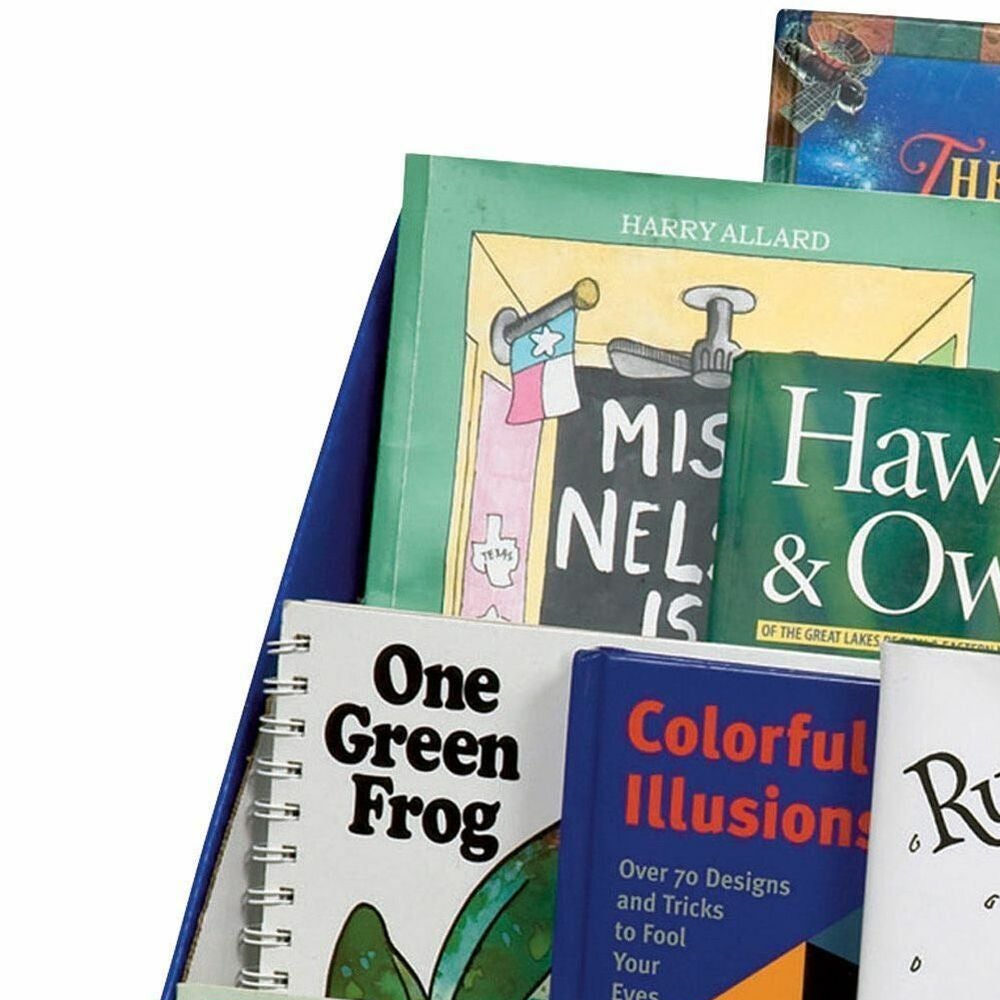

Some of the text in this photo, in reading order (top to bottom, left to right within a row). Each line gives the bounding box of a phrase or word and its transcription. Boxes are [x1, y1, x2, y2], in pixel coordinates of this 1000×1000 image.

[620, 214, 831, 252] HARRY ALLARD
[556, 486, 718, 584] NEL
[762, 534, 831, 607] &
[641, 589, 703, 640] IS
[761, 624, 777, 637] OF
[780, 625, 802, 640] THE
[804, 627, 842, 644] GREAT
[845, 631, 880, 647] LAKES
[373, 643, 501, 713] One
[324, 703, 521, 781] Green
[627, 699, 870, 776] Colorful
[347, 773, 501, 863] Frog
[619, 858, 791, 898] Over 70 Designs
[617, 892, 725, 920] and Tricks
[614, 921, 686, 947] to Fool
[613, 951, 661, 976] Your
